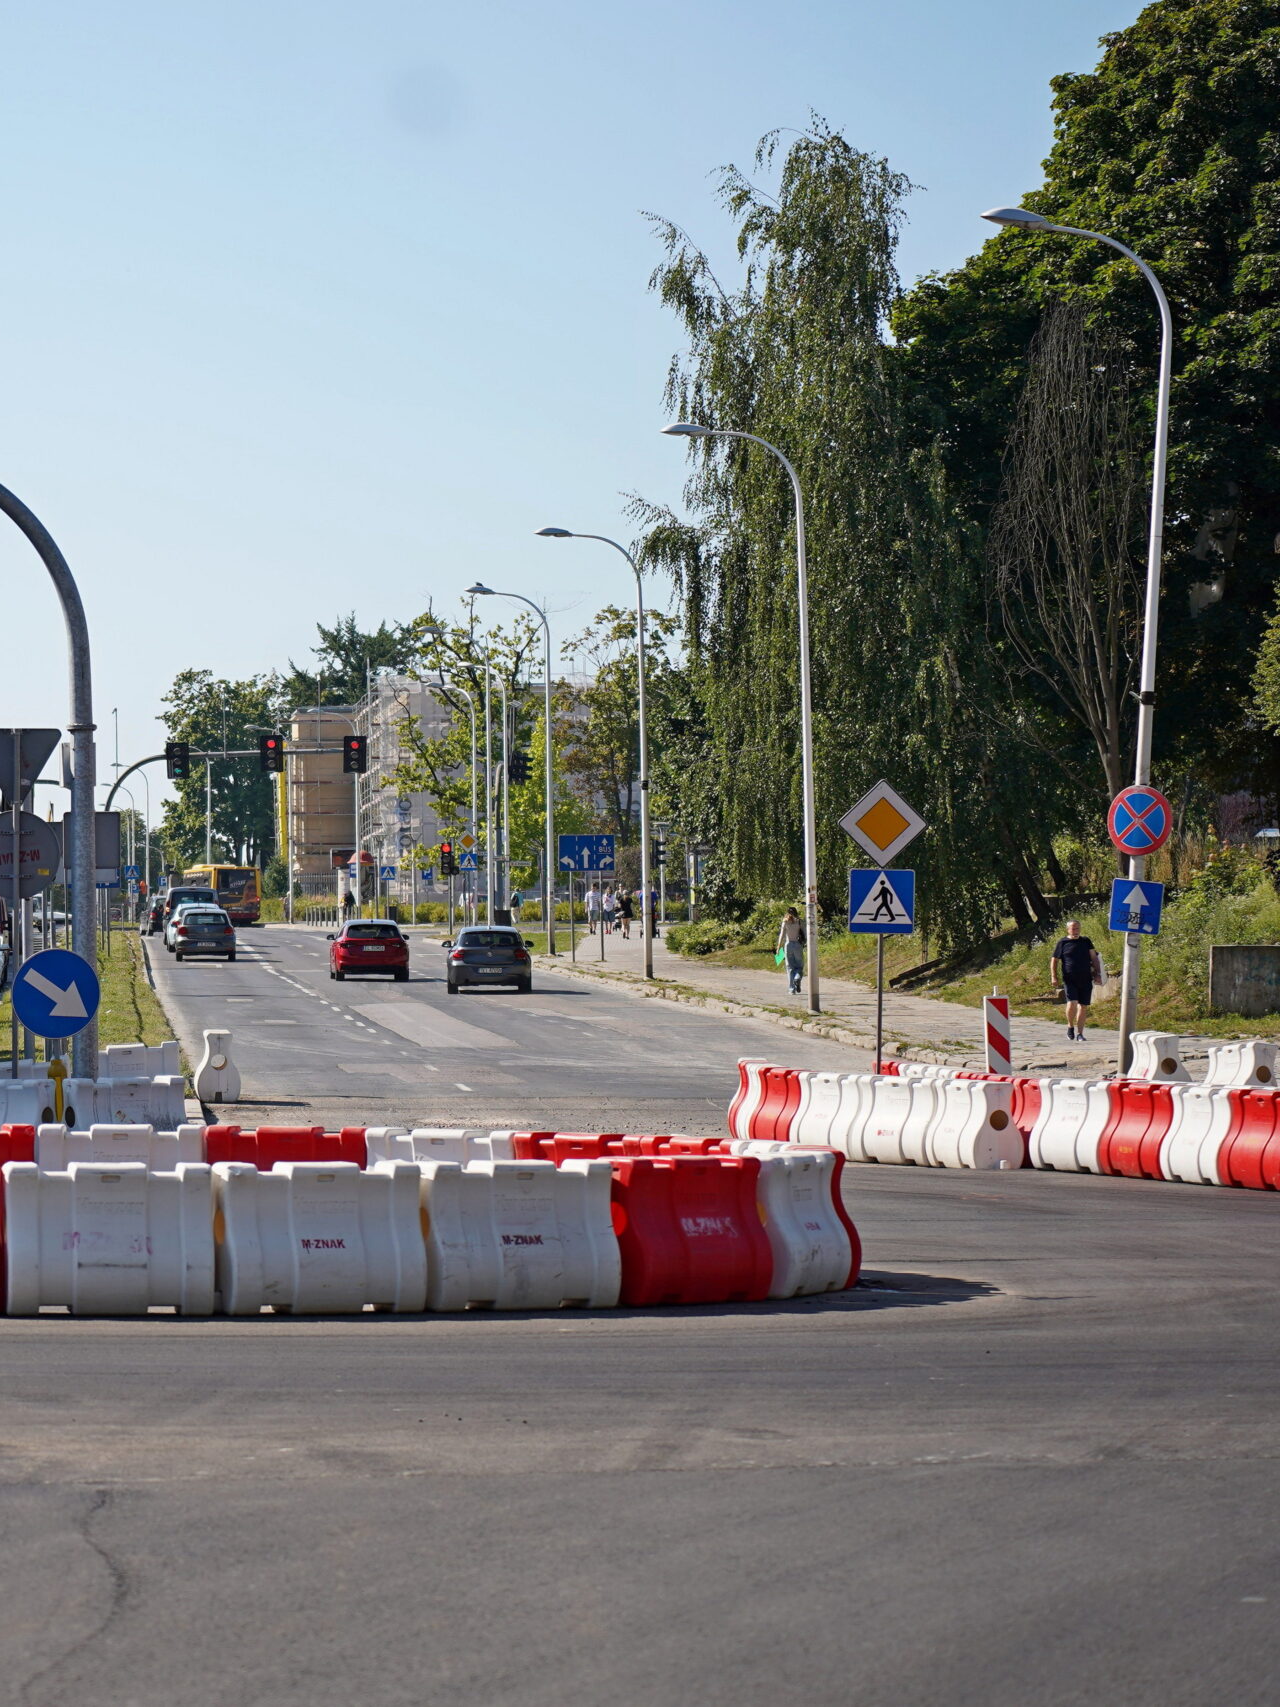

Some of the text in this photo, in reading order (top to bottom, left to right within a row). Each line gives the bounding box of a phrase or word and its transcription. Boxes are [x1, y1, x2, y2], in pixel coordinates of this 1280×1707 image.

[598, 845, 612, 853] BUS
[301, 1238, 346, 1249] M-ZNAK
[501, 1234, 544, 1246] M-ZNAK
